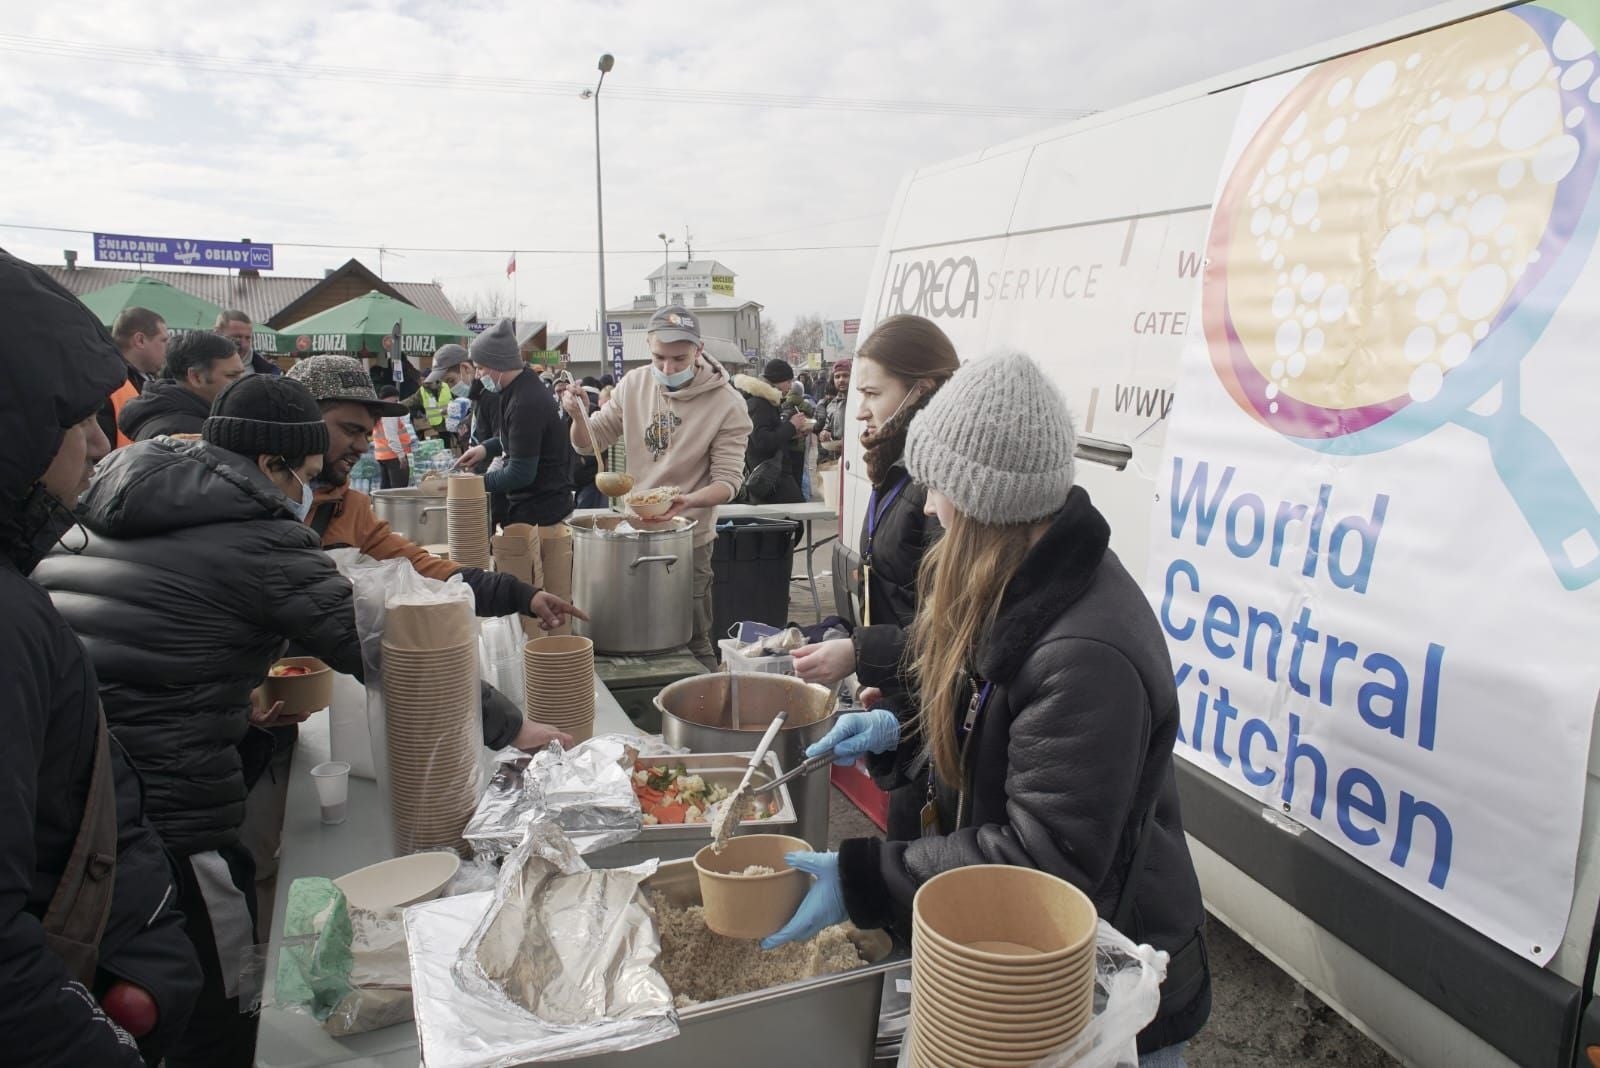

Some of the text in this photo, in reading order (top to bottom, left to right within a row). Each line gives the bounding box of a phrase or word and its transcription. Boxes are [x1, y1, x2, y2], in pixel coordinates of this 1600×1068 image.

[98, 236, 168, 253] ŚNIADANIA
[100, 250, 155, 262] KOLACJE
[205, 249, 270, 262] OBIADY WC
[887, 256, 1103, 318] HORECA SERVICE
[1134, 311, 1191, 336] CATE
[312, 334, 347, 351] ŁOMŻA
[401, 335, 436, 351] ŁOMŻA
[1170, 457, 1390, 594] World
[1160, 559, 1446, 751] Central
